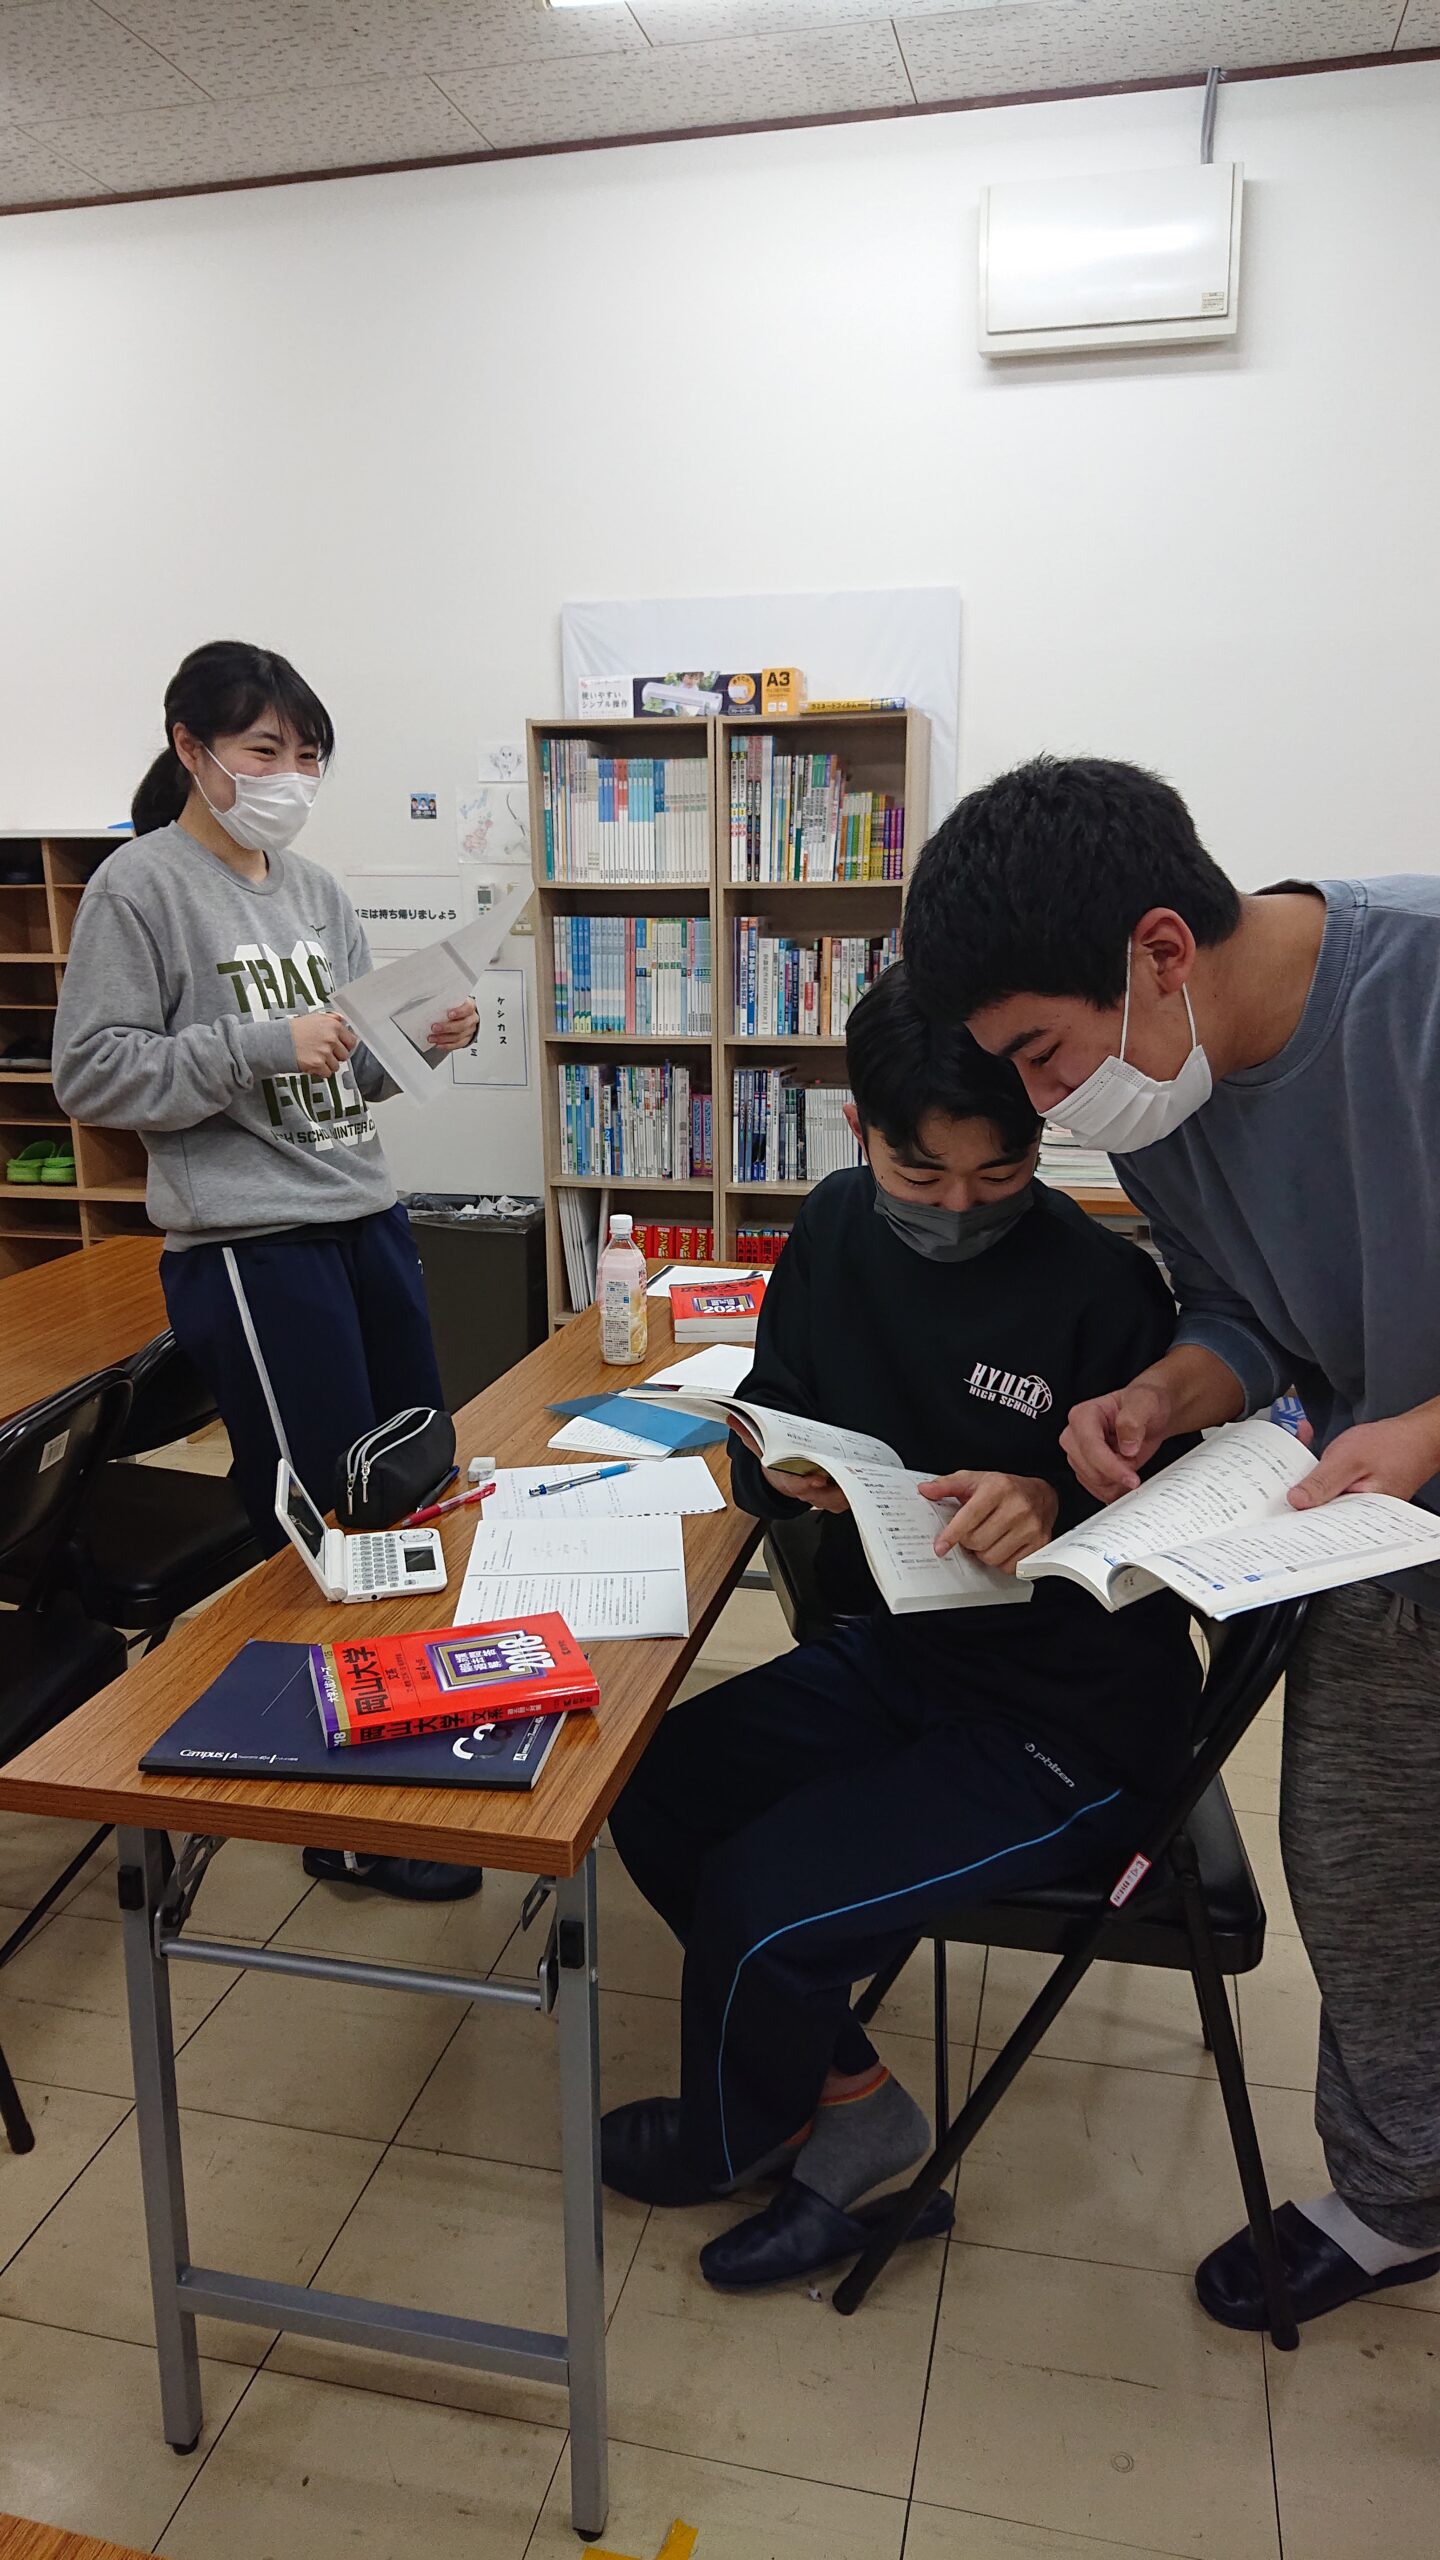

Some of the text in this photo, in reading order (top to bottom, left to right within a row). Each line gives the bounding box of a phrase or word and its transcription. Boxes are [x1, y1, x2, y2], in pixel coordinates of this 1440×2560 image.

[582, 690, 622, 700] 使いやすい
[767, 671, 791, 687] A3
[581, 699, 628, 709] シンプル操作
[496, 996, 508, 1045] ケシカス
[703, 1304, 746, 1314] 2021
[968, 1384, 1039, 1420] HIGH SCHOOL
[969, 1362, 1041, 1408] HYUGA
[497, 1635, 557, 1673] 2018
[320, 1666, 339, 1703] 大学入試シリーズ
[341, 1645, 392, 1716] 岡山大学
[359, 1713, 465, 1742] 岡山大学
[471, 1708, 504, 1723] 文系
[179, 1749, 225, 1760] Campus
[1033, 1752, 1076, 1788] phiten
